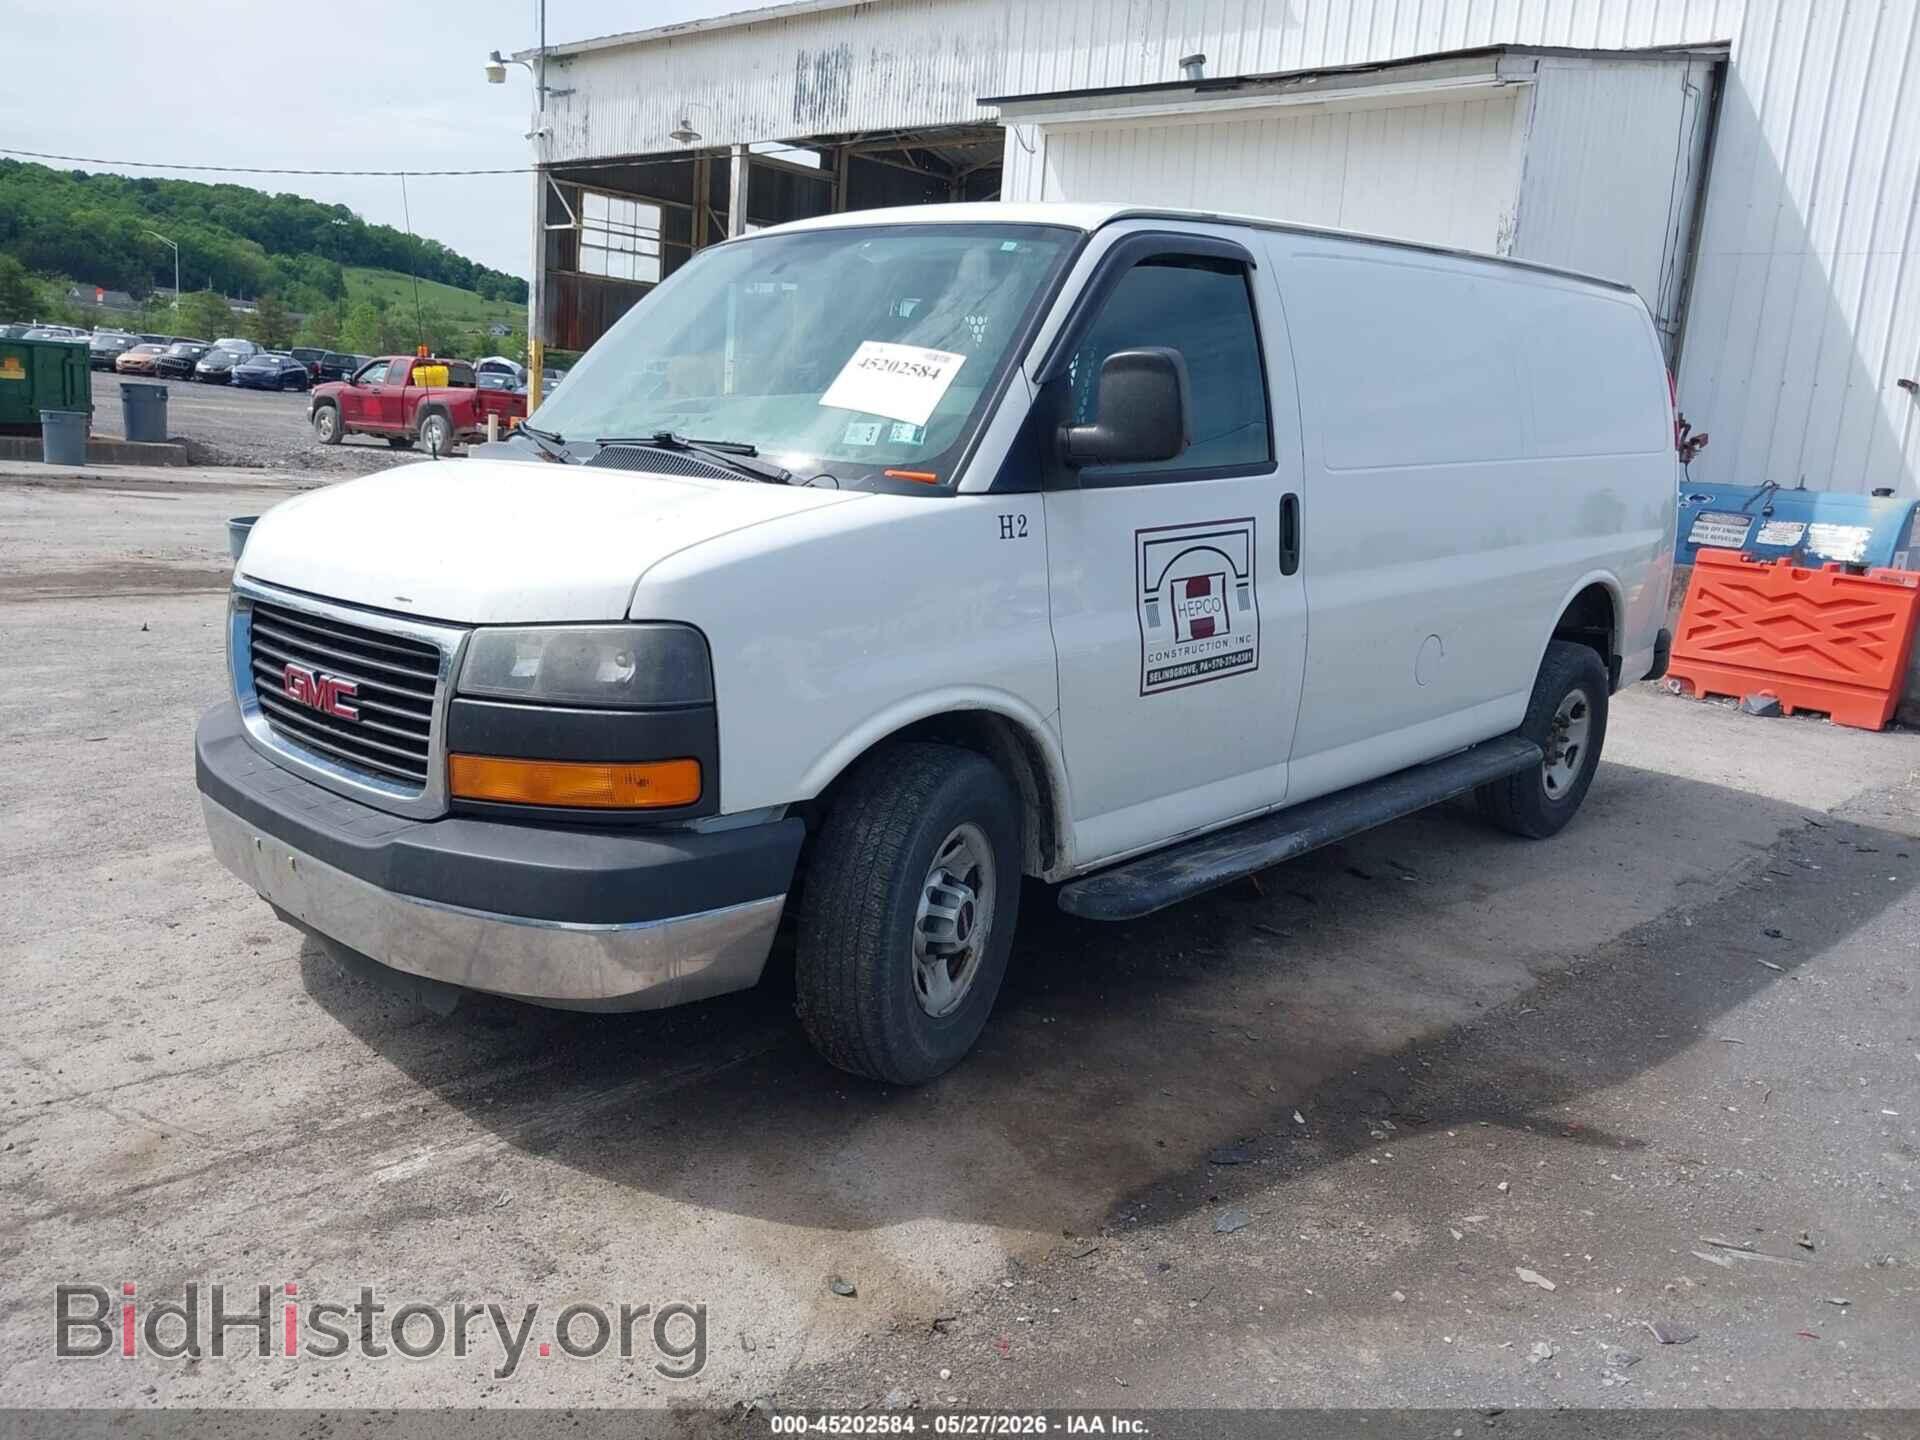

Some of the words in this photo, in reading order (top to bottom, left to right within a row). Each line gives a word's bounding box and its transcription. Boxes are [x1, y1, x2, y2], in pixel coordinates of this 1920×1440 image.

[858, 357, 942, 380] 45202584
[998, 514, 1028, 539] H2
[1177, 597, 1222, 618] HEPCO
[284, 663, 359, 721] GMC
